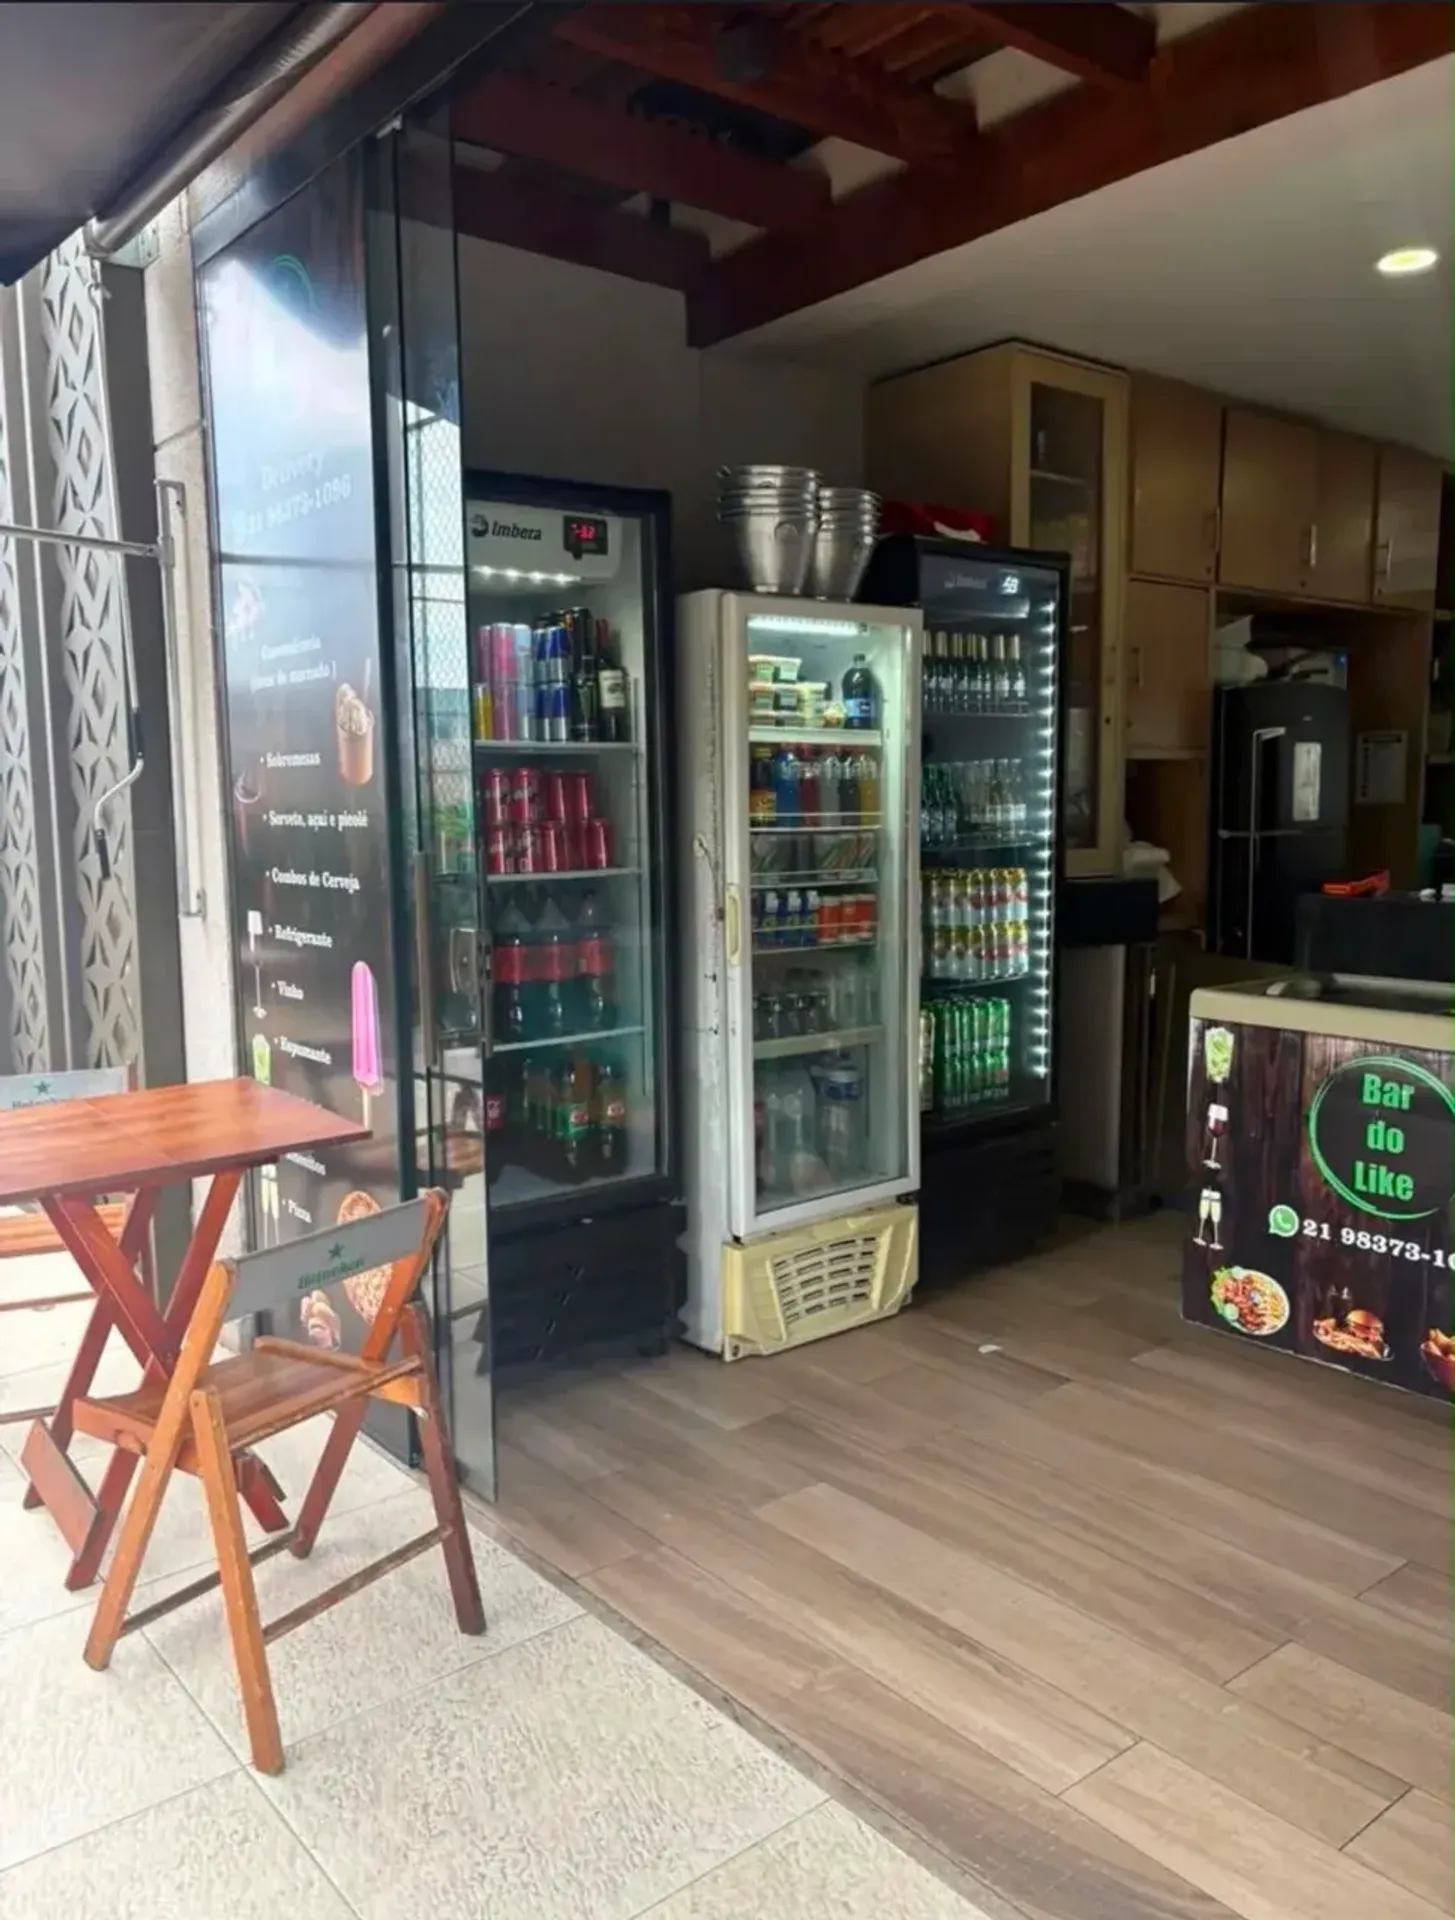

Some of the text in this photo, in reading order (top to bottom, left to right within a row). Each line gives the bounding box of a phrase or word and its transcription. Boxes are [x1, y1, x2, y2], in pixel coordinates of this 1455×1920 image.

[491, 520, 542, 541] Imbera
[265, 751, 321, 768] Sobremesas
[268, 809, 306, 828] Sorvete,
[329, 814, 336, 828] e
[272, 867, 360, 894] Combos de Cerveja
[274, 924, 333, 948] Refrigerante
[276, 980, 304, 1000] Vinho
[1362, 1072, 1415, 1110] Bar
[1366, 1119, 1405, 1154] do
[1354, 1160, 1414, 1201] Like
[1302, 1218, 1331, 1241] 21
